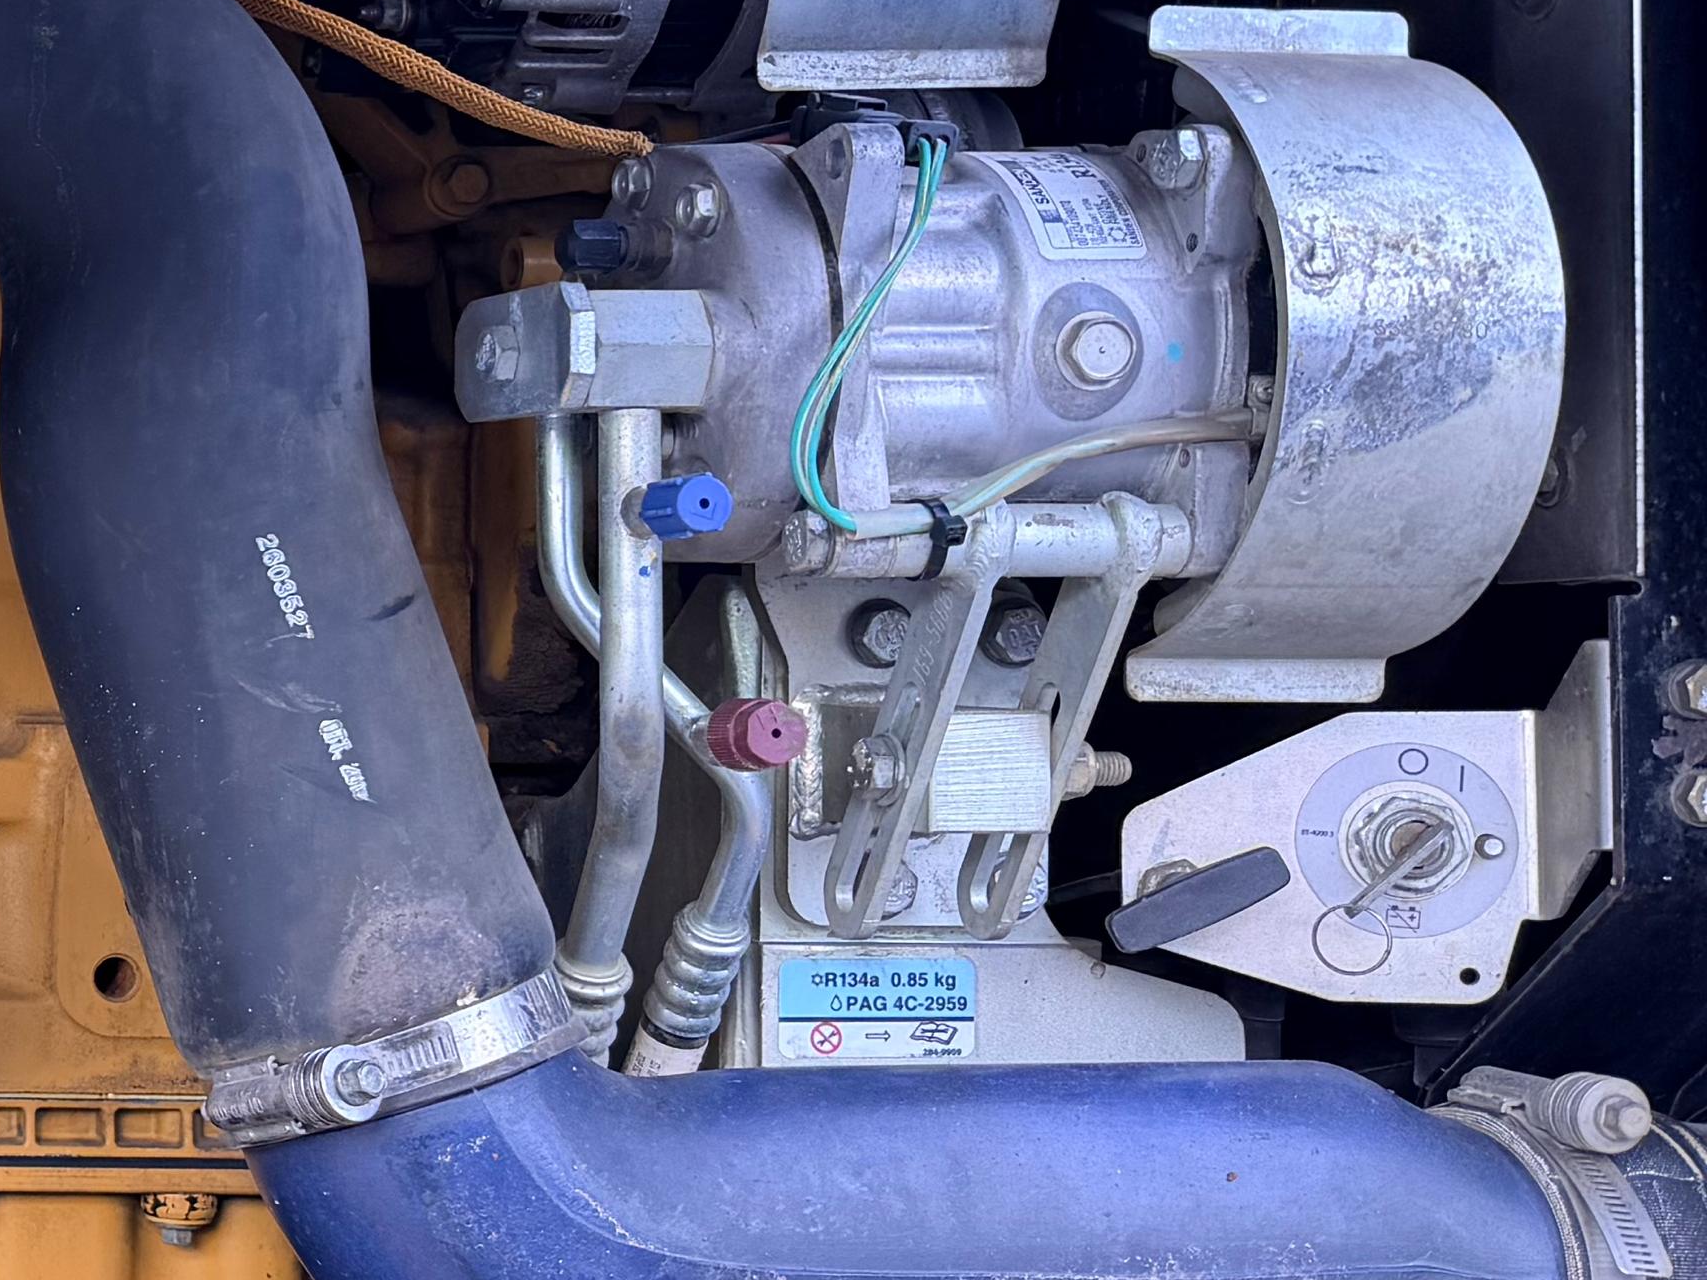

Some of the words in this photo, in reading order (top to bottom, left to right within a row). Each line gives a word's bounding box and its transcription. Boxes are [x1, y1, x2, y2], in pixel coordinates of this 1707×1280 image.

[824, 972, 880, 988] R134a
[890, 972, 928, 988] 0.85
[935, 972, 957, 991] kg
[846, 996, 887, 1012] PAG
[893, 996, 968, 1012] 4C-2959
